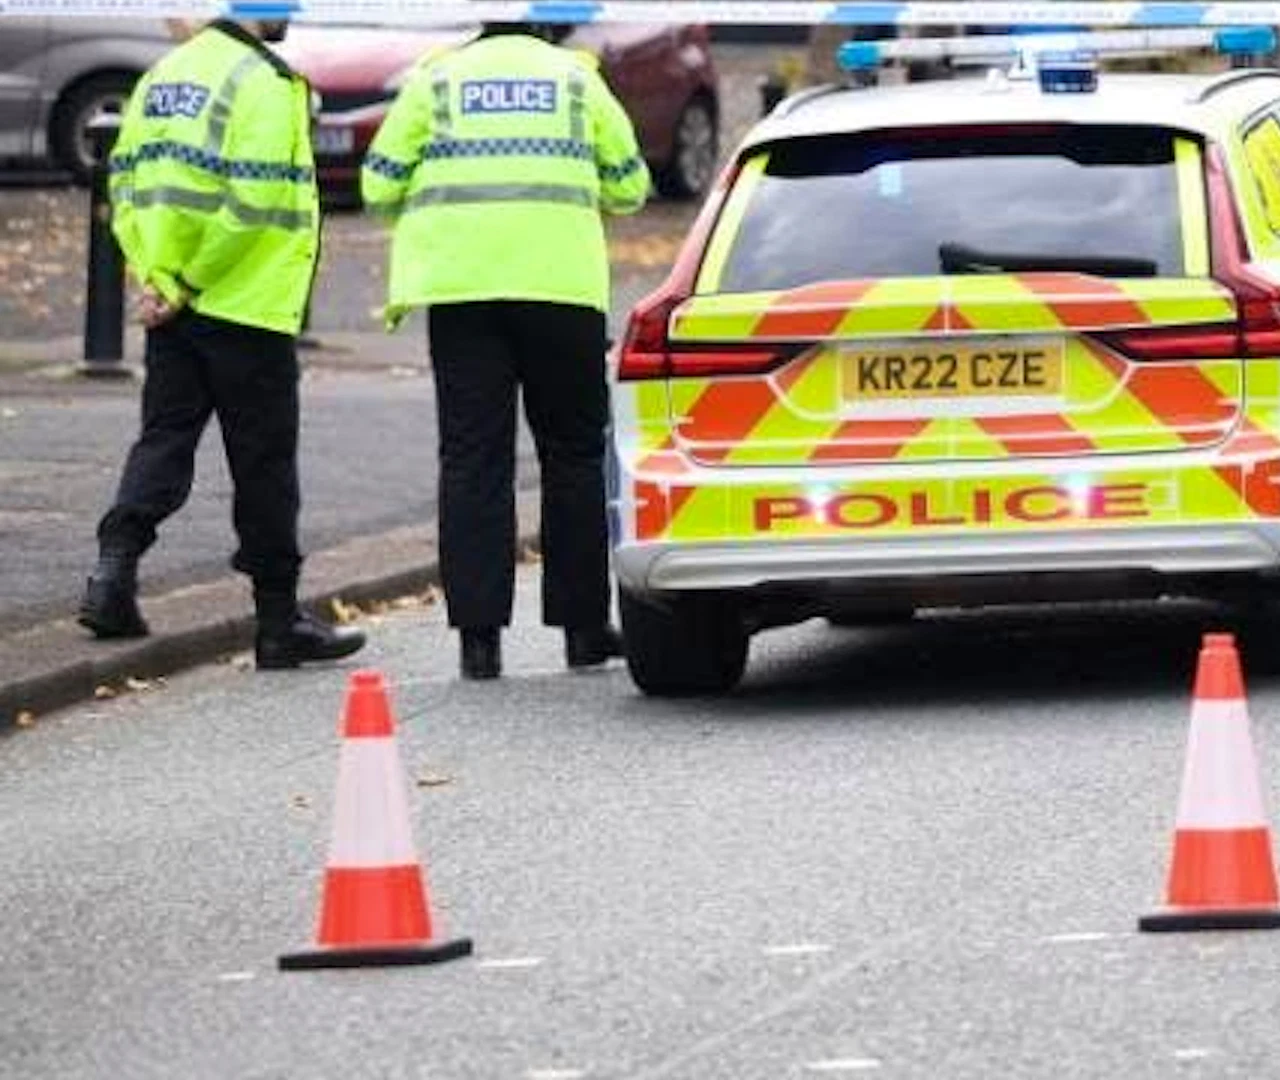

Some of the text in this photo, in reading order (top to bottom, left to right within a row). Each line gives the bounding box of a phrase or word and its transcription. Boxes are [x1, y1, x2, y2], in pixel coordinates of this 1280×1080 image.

[463, 83, 553, 110] POLICE
[857, 351, 1046, 391] KR22 CZE
[754, 483, 1150, 531] POLICE
